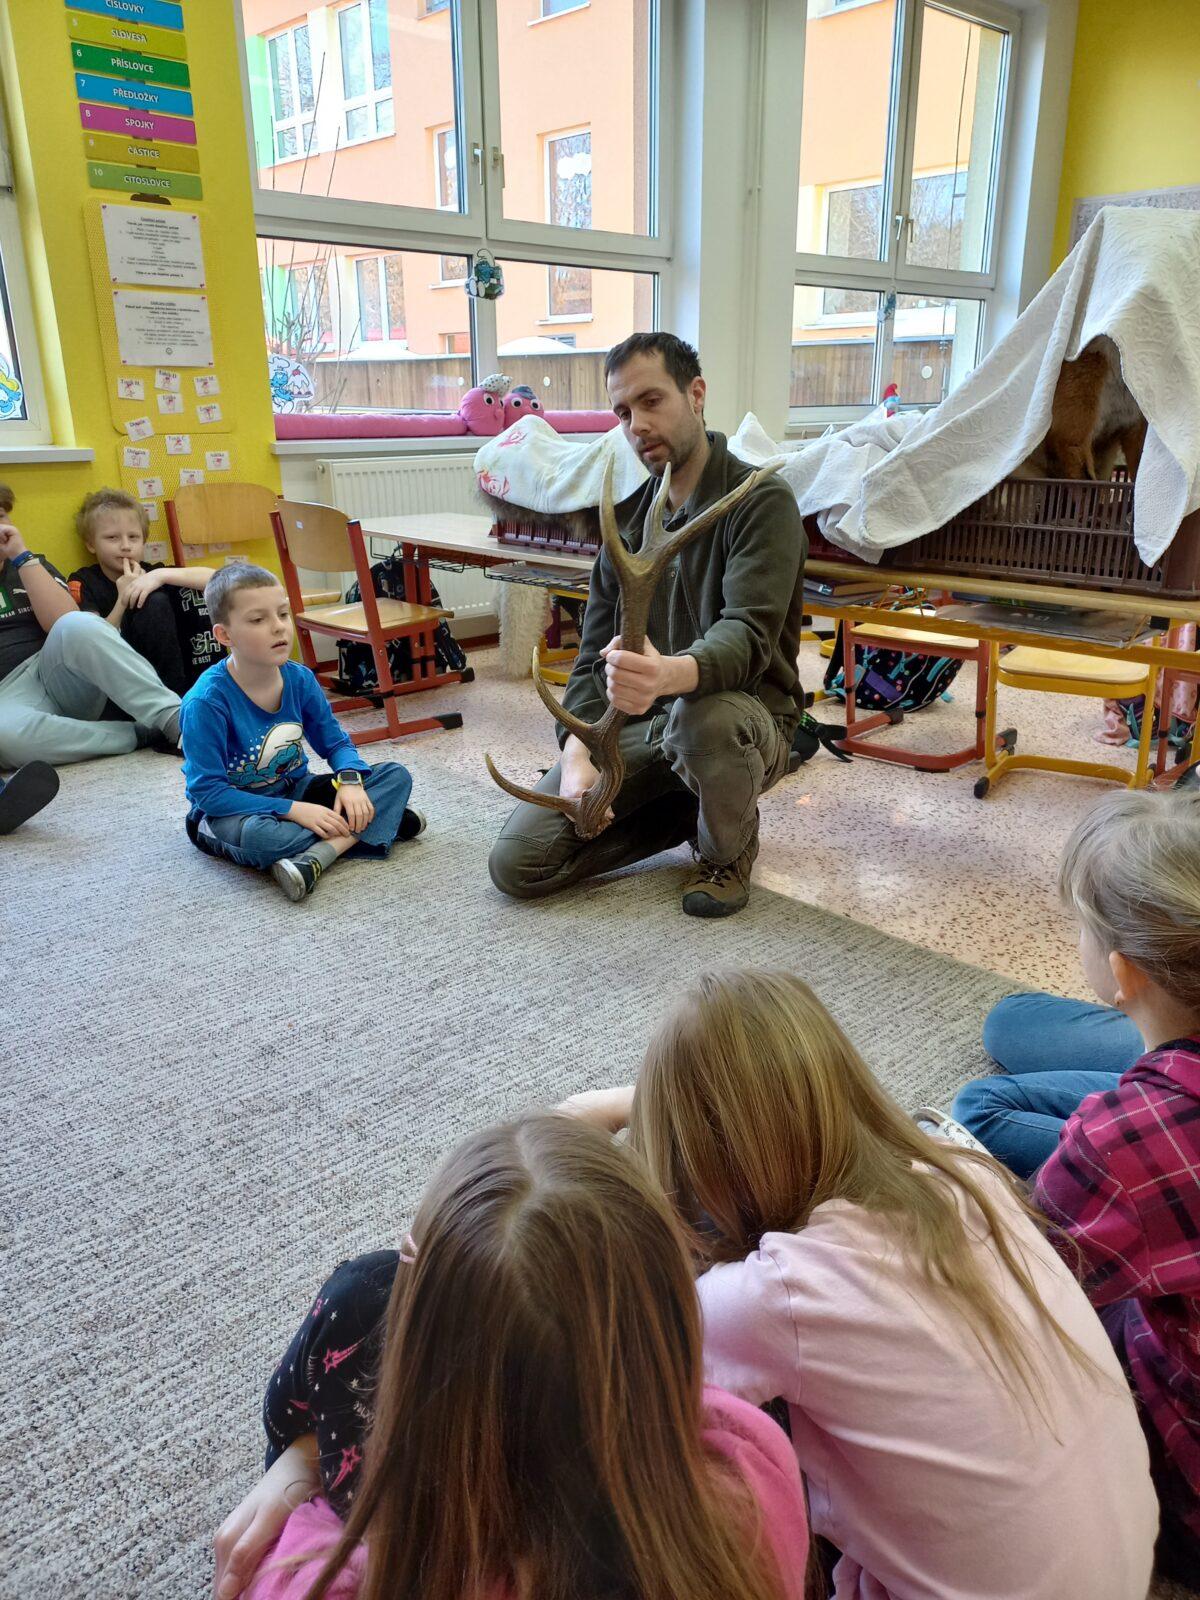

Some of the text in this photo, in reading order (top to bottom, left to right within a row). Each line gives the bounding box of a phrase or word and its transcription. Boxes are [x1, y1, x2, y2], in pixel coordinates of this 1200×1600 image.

[111, 29, 147, 44] SLOVESA
[76, 49, 154, 74] 6 PŘÍSLOVCE
[80, 79, 159, 103] 7 PŘEDLOŽKY
[125, 118, 154, 130] SPOJKY
[94, 168, 171, 188] 10 CITOSLOVCE
